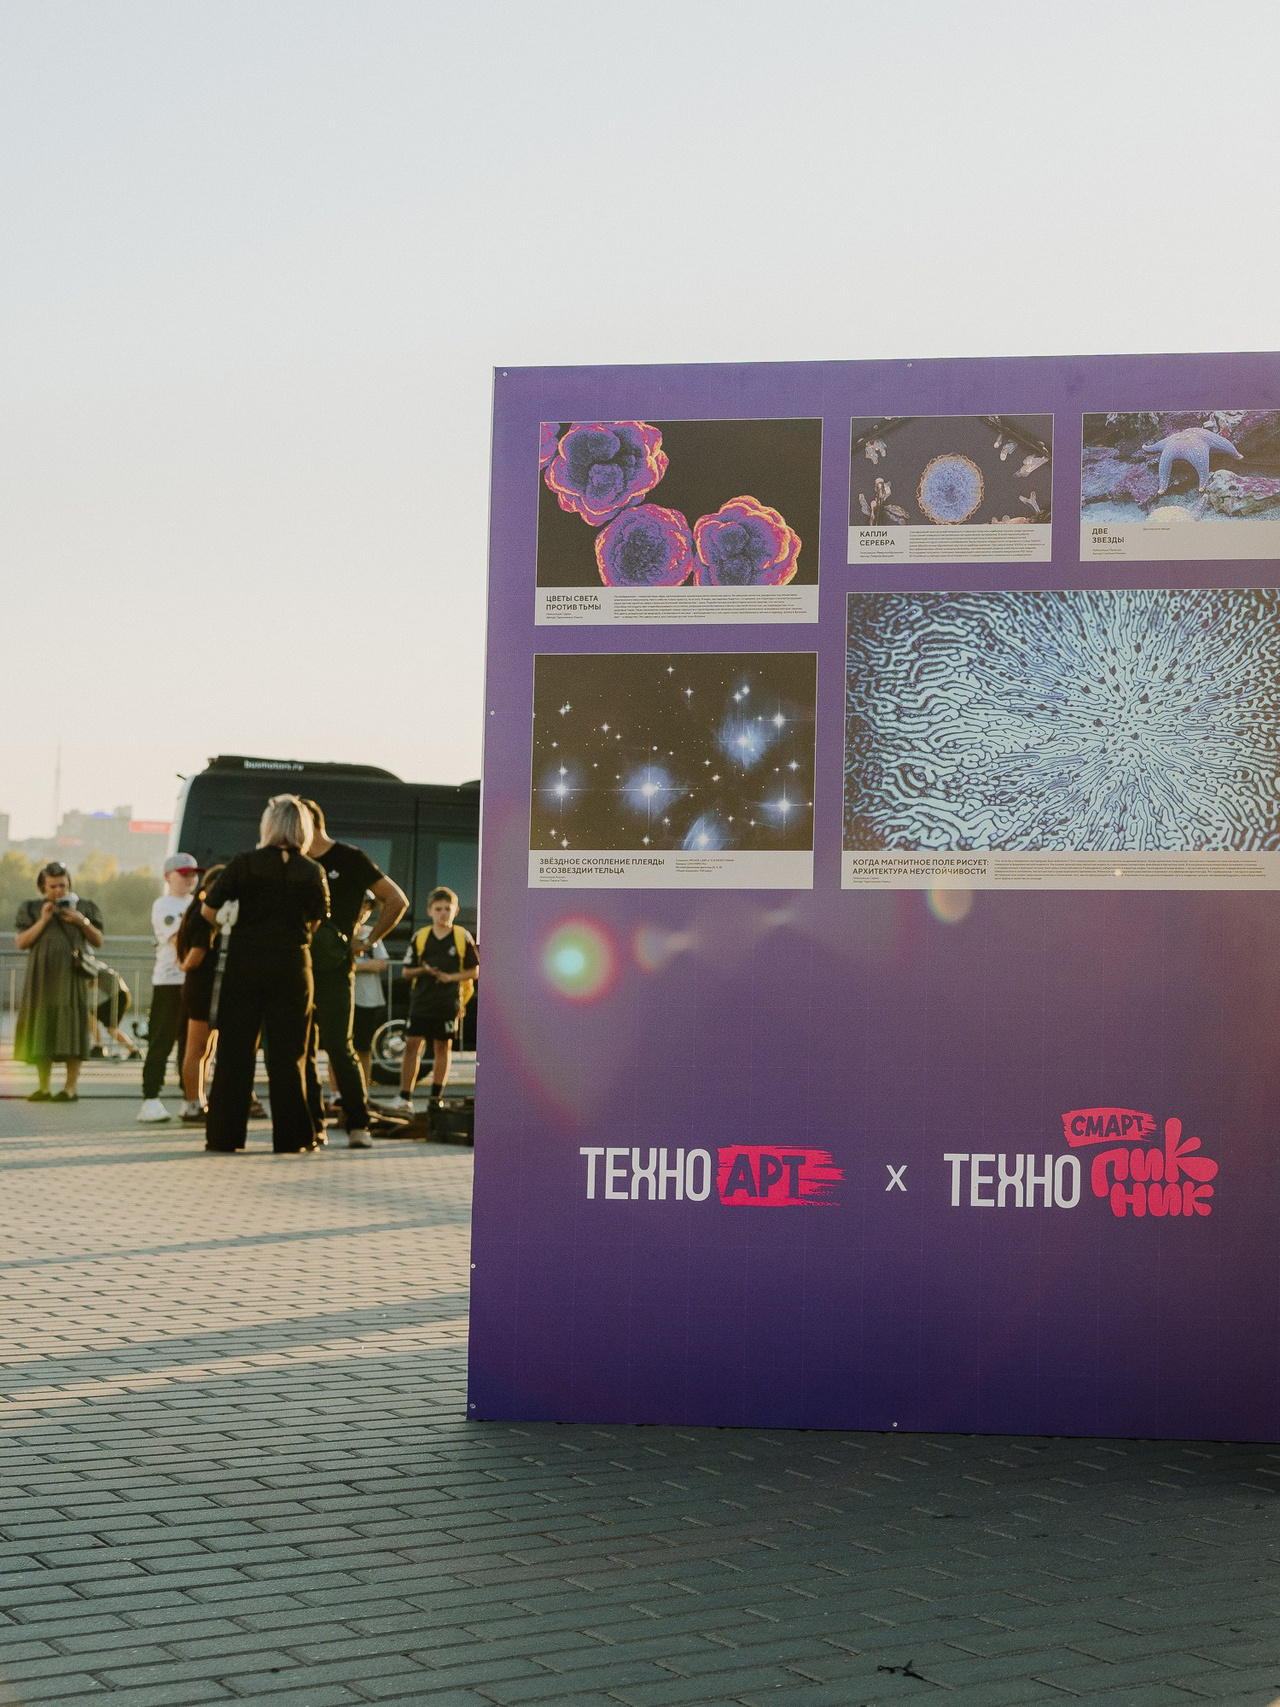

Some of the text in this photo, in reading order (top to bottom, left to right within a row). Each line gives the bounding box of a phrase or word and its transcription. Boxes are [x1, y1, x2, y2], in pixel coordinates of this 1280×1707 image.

[859, 530, 888, 538] КАПЛИ
[1091, 527, 1109, 536] ДВЕ
[859, 539, 896, 547] СЕРЕБРА
[1091, 536, 1125, 544] ЗВЕЗДЫ
[579, 603, 602, 611] ТЬМЫ
[539, 857, 665, 866] ЗВЁЗДНОЕ СКОПЛЕНИЕ ПЛЕЯДЫ
[545, 867, 593, 875] СОЗВЕЗДИИ
[594, 867, 625, 875] ТЕЛЬЦА
[910, 867, 987, 875] НЕУСТОЙЧИВОСТИ
[1070, 1114, 1144, 1138] СМАРТ
[579, 1147, 806, 1202] ТЕХНО АРТ
[944, 1153, 1081, 1209] ТЕХНО
